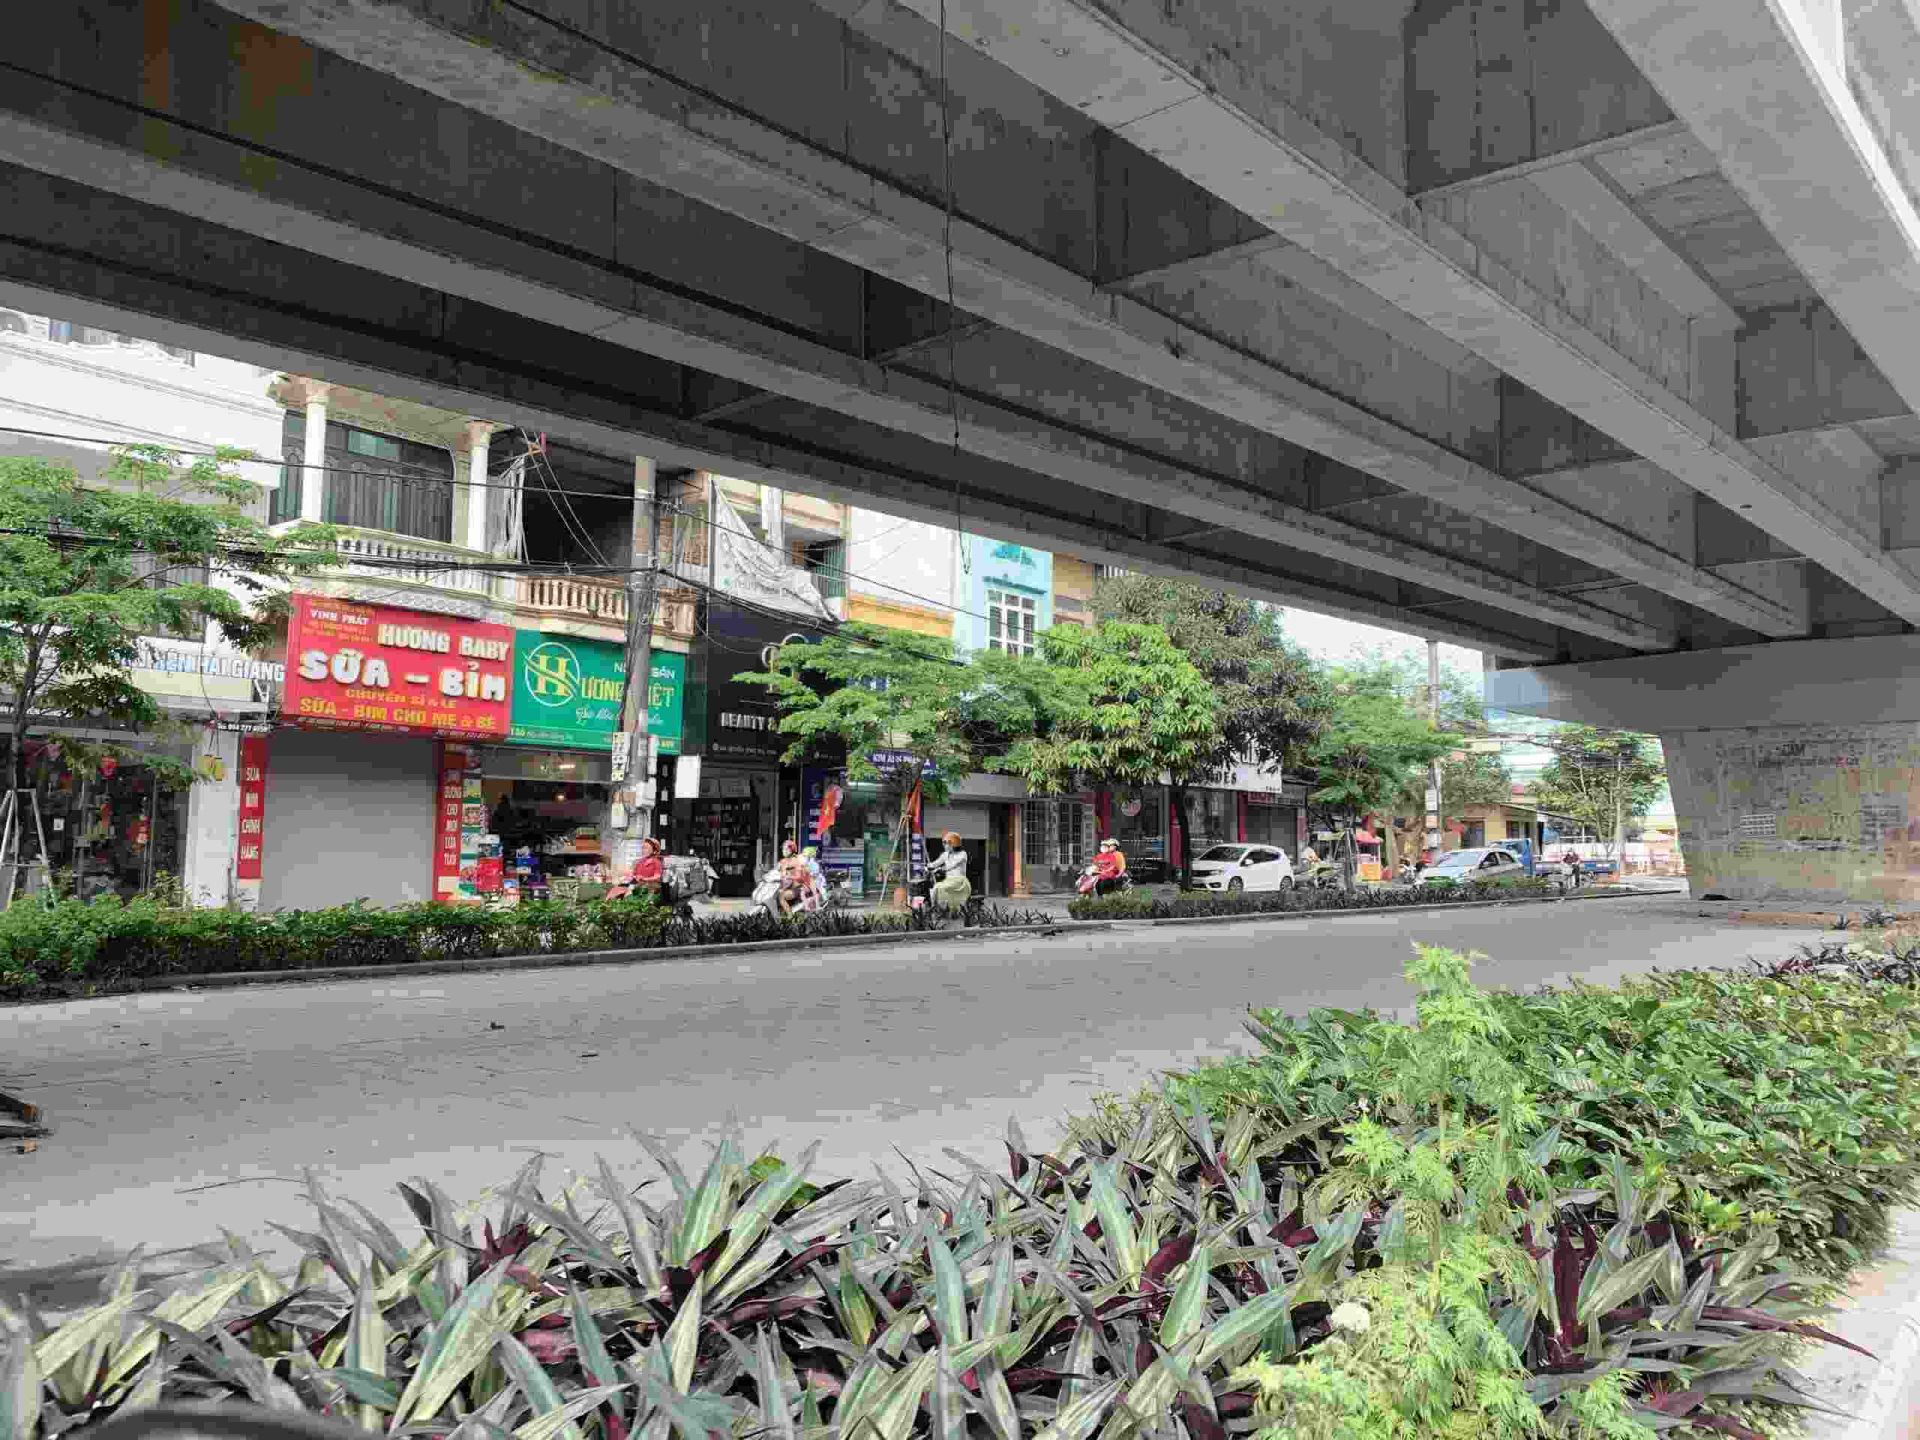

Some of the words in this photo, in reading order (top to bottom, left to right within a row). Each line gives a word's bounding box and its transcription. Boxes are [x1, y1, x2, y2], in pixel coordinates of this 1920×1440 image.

[459, 635, 510, 661] BABY
[231, 656, 286, 682] GIANG
[721, 712, 765, 731] BEAUTY
